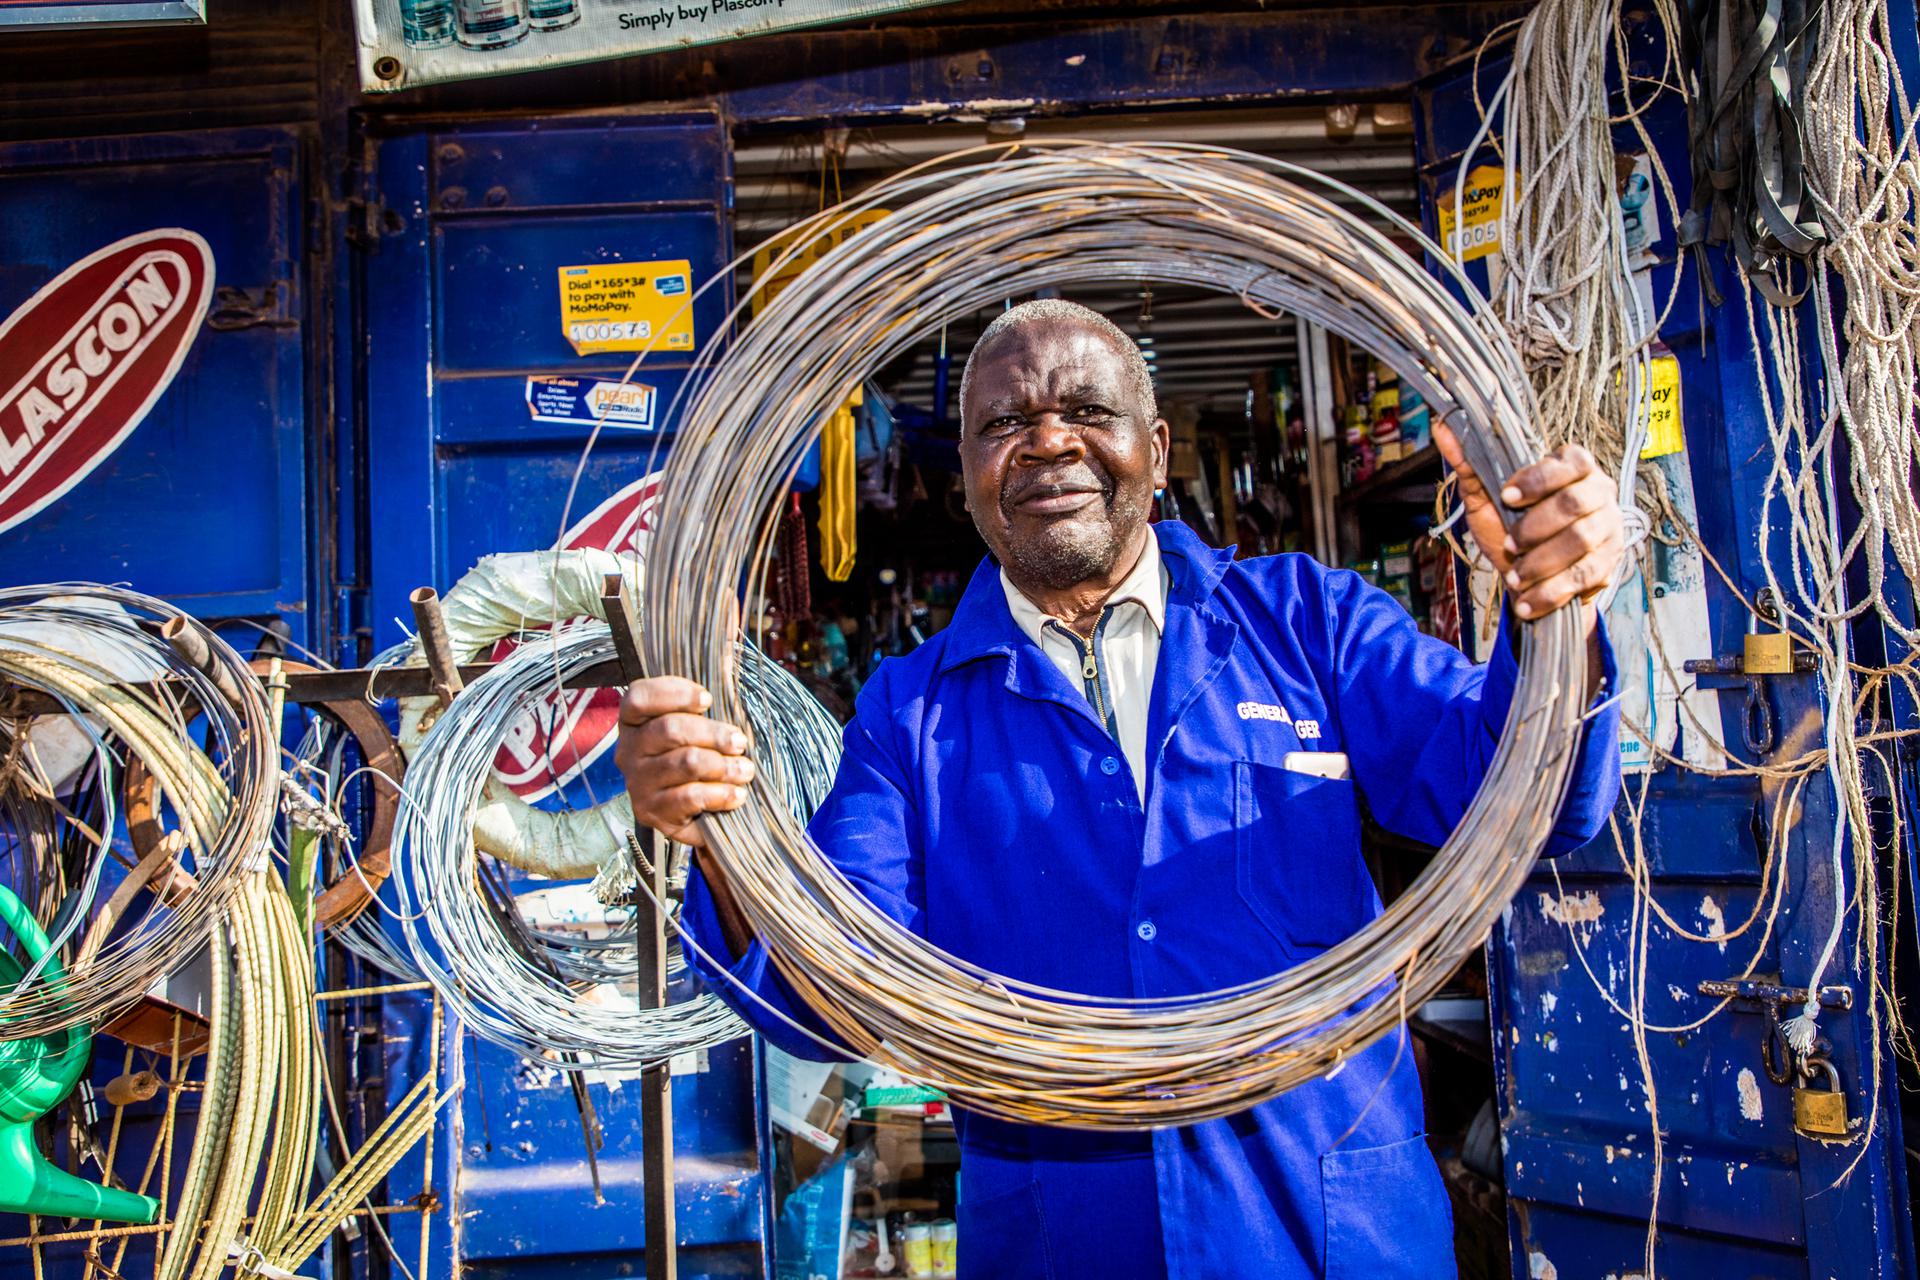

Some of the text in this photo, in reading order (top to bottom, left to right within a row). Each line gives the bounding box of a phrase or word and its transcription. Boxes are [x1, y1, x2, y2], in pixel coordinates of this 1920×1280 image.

[618, 8, 674, 30] Simply
[678, 5, 708, 22] buy
[712, 0, 773, 14] Plascon
[568, 280, 592, 290] Dial
[569, 289, 635, 303] to pay with
[570, 302, 632, 313] MoMoPay.
[595, 387, 645, 406] pearl
[1236, 702, 1293, 726] GENERA
